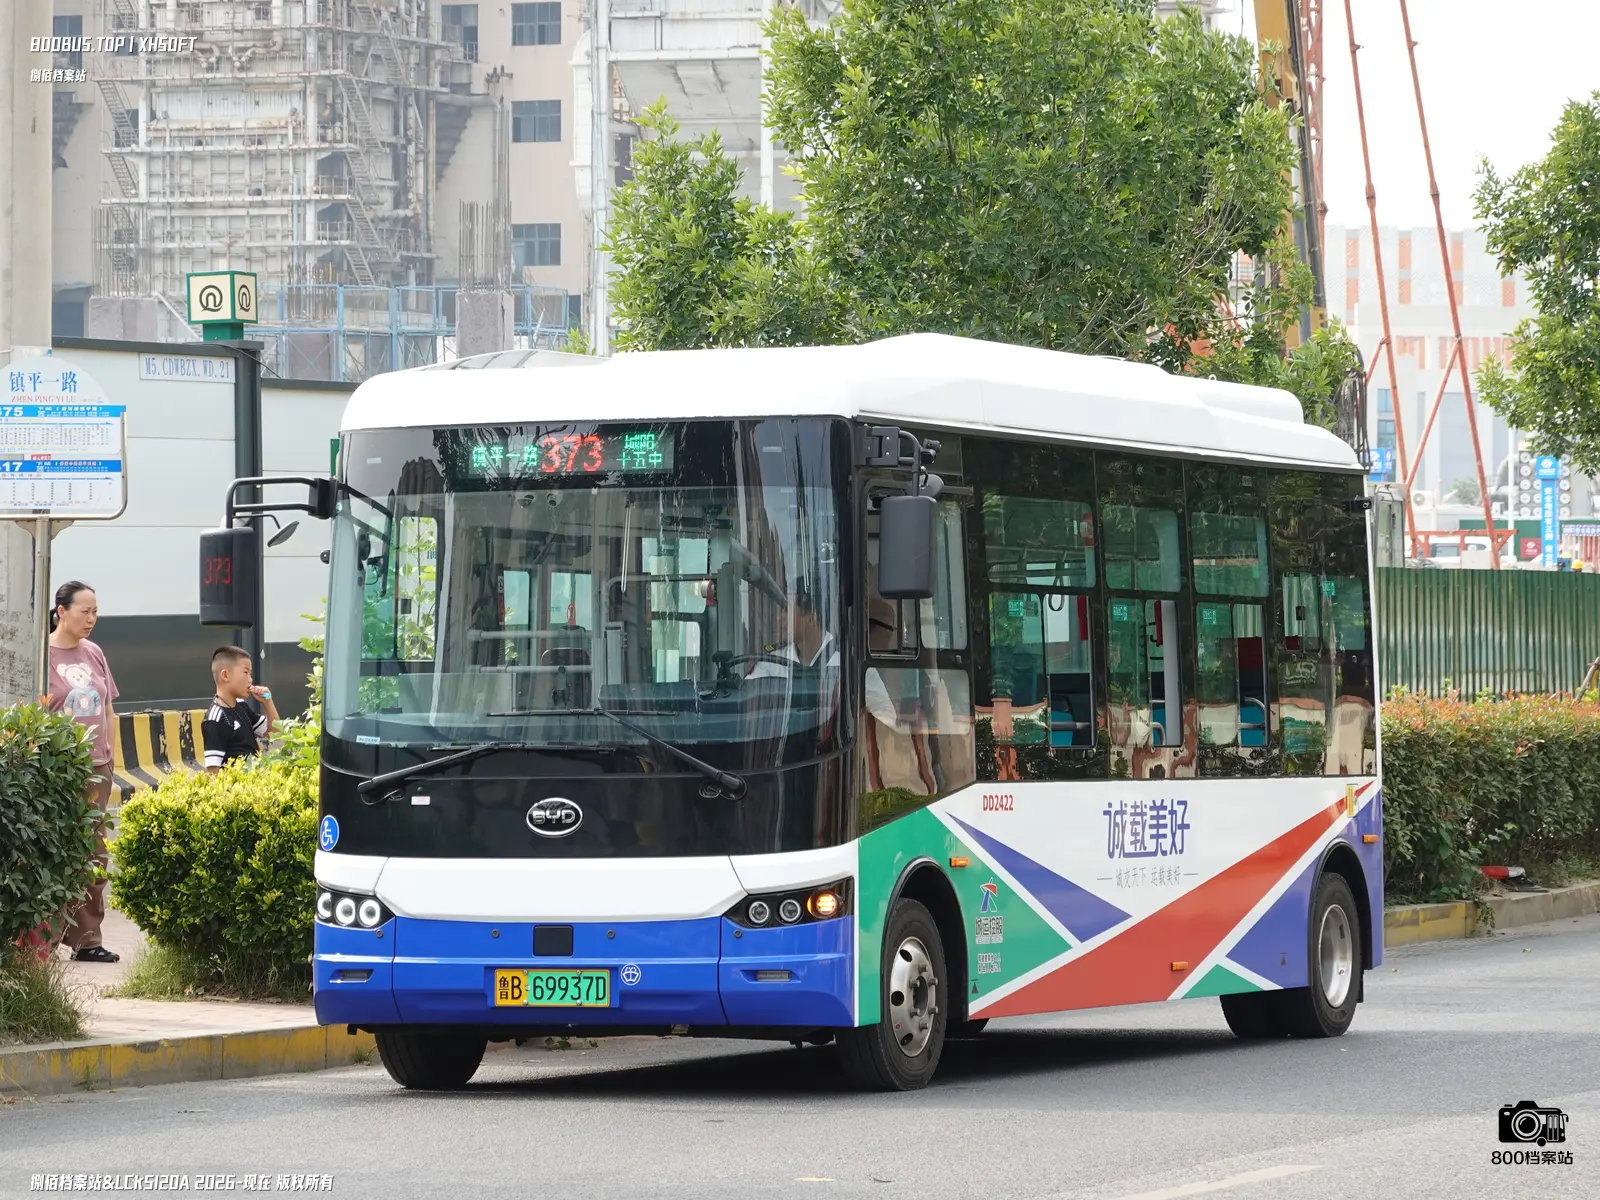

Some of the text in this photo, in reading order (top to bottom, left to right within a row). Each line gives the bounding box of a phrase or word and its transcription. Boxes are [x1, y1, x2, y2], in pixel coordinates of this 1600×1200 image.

[9, 371, 78, 393] 镇平一路
[11, 395, 33, 403] ZHEN
[34, 395, 54, 403] PING
[56, 395, 64, 403] YI
[65, 395, 76, 403] LU
[0, 406, 24, 417] 75
[472, 446, 539, 468] 镇平一路
[541, 434, 602, 473] 373
[616, 451, 663, 469] 十五中
[0, 461, 23, 472] 17
[203, 557, 232, 585] 373
[982, 794, 1014, 812] DD2422
[532, 809, 576, 825] BYD
[1102, 798, 1191, 859] 诚载美好
[498, 975, 607, 1001] 鲁B 69937D
